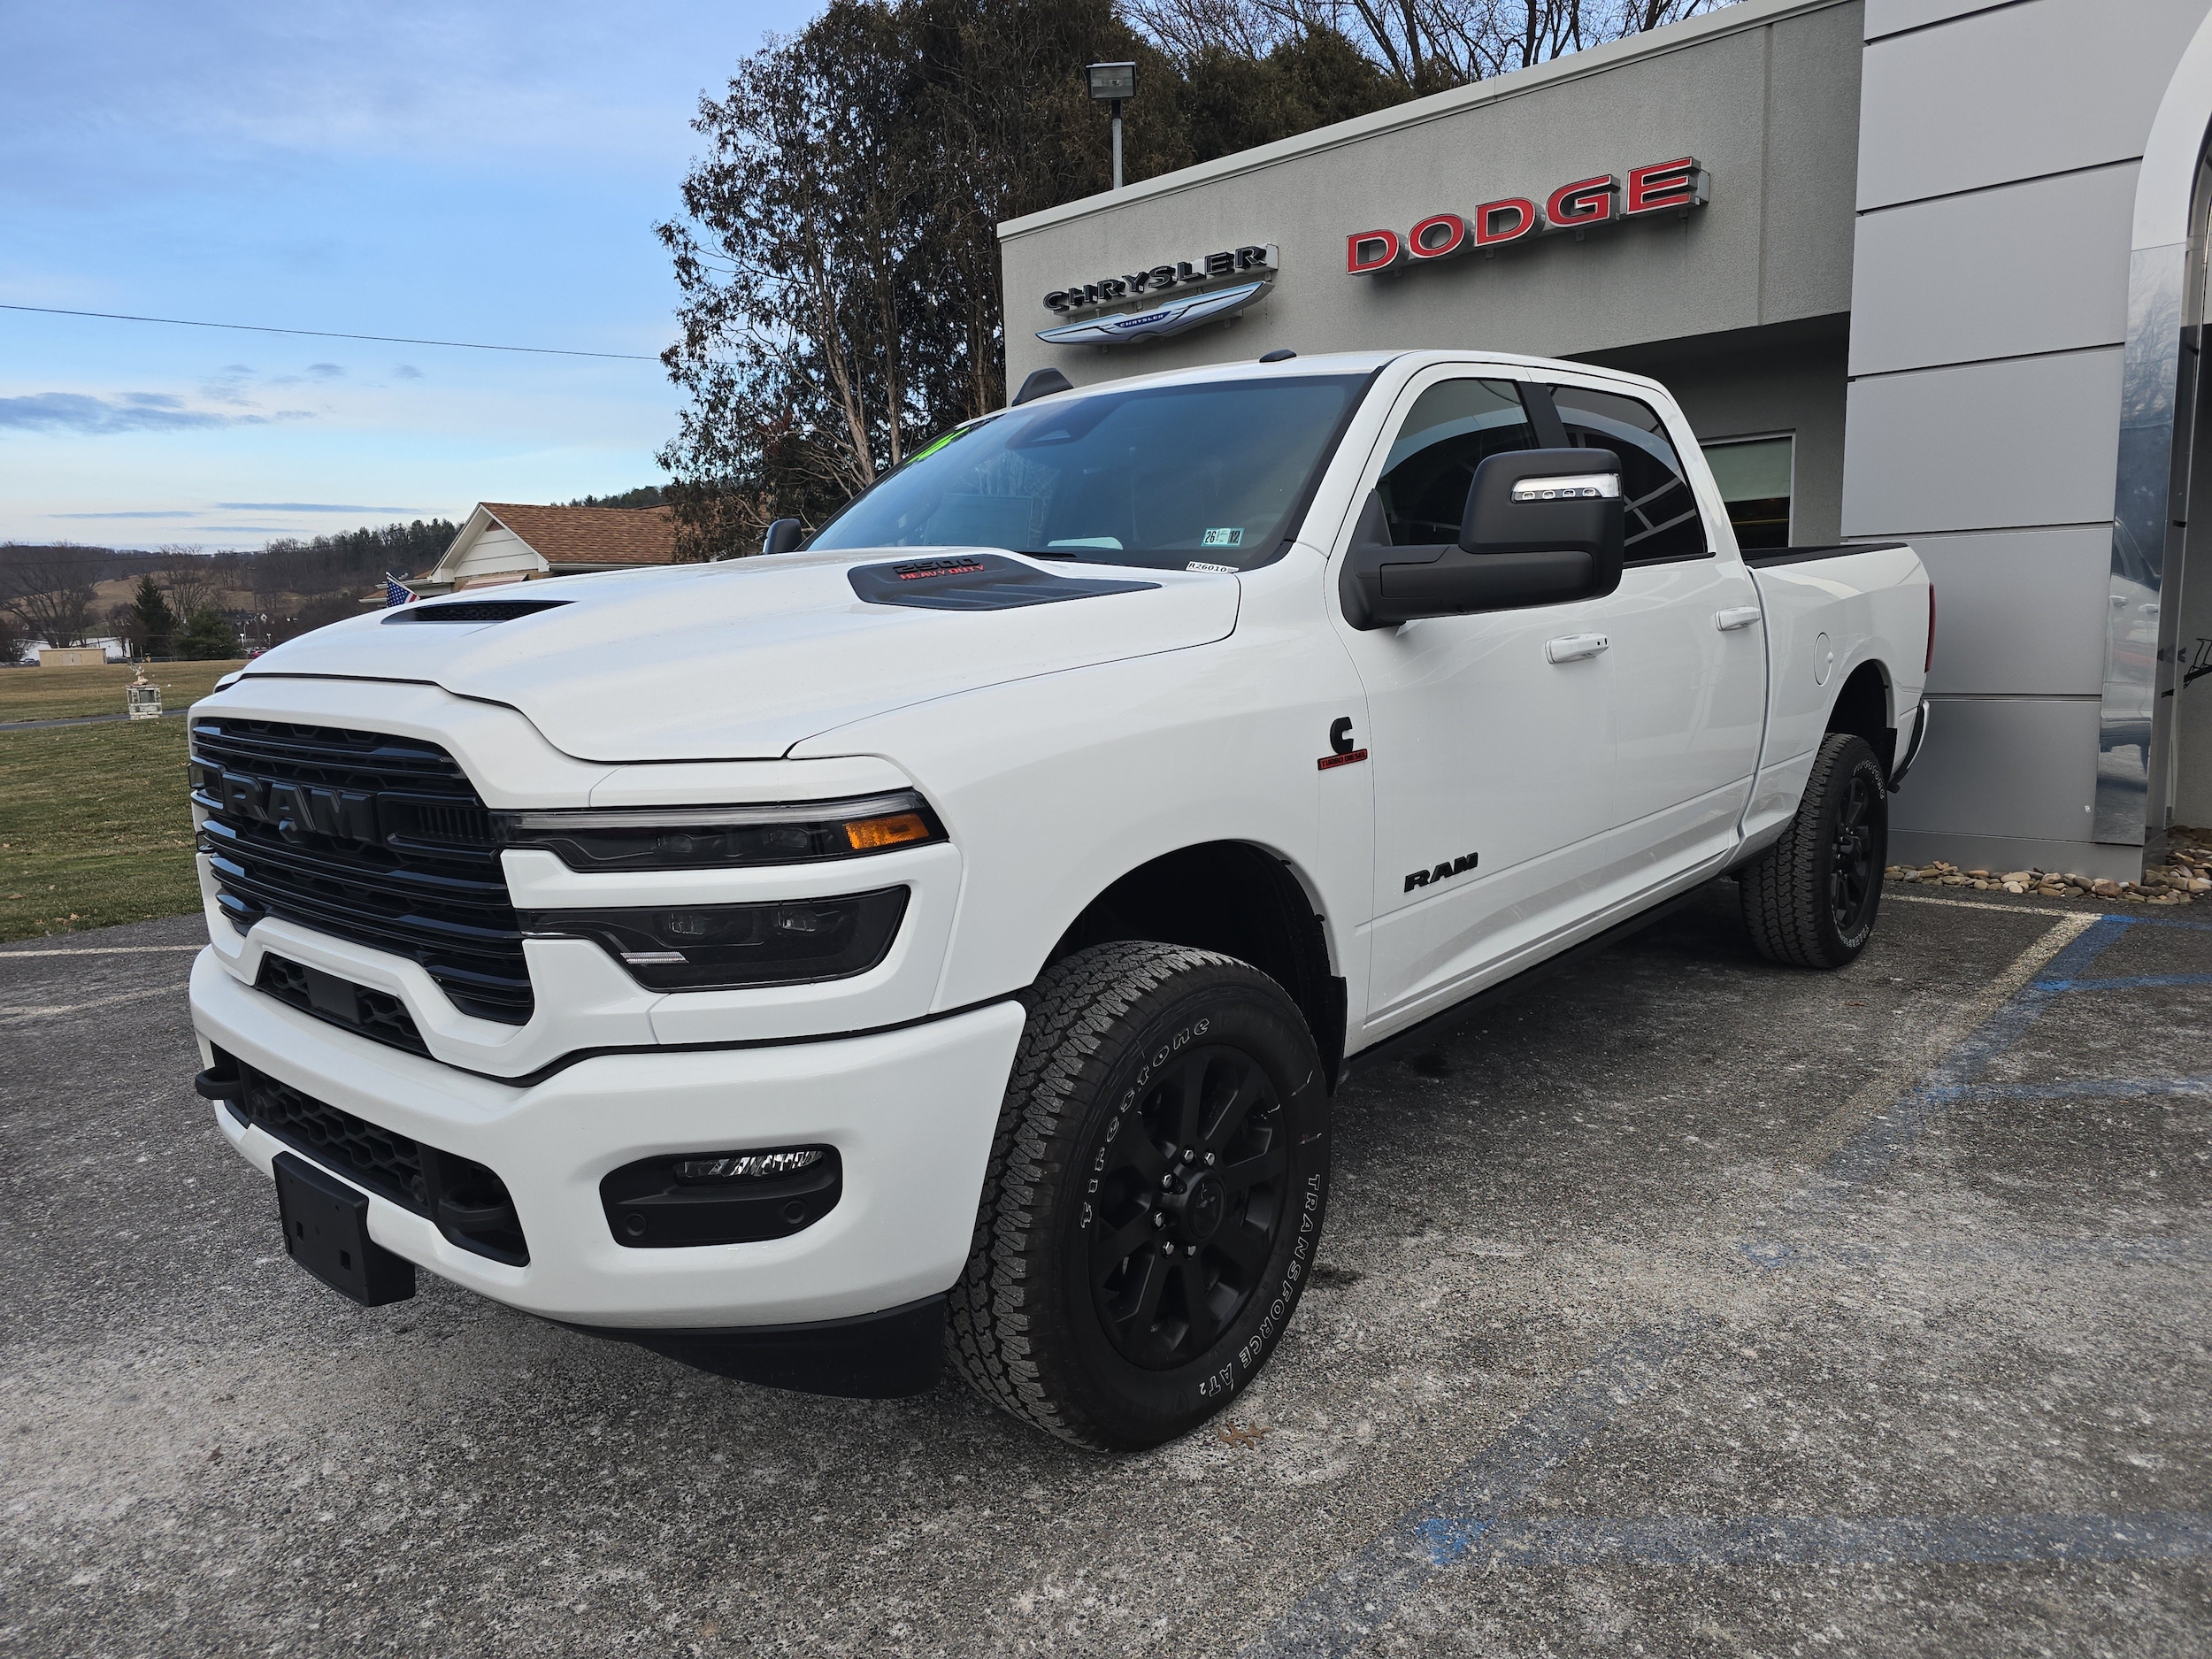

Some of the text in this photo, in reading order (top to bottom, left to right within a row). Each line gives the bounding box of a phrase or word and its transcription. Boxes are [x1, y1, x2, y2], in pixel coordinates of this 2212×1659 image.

[1346, 156, 1700, 276] DODGE
[1043, 245, 1267, 311] CHRYSLER
[1119, 312, 1164, 328] CHRYSLER
[1204, 530, 1217, 543] 26
[892, 558, 980, 574] 2500
[900, 564, 985, 581] HEAVY DUTY
[1188, 562, 1227, 573] R26010
[222, 771, 380, 843] RAM
[1403, 851, 1479, 893] RAM
[1239, 1173, 1321, 1370] TRANSFORCE
